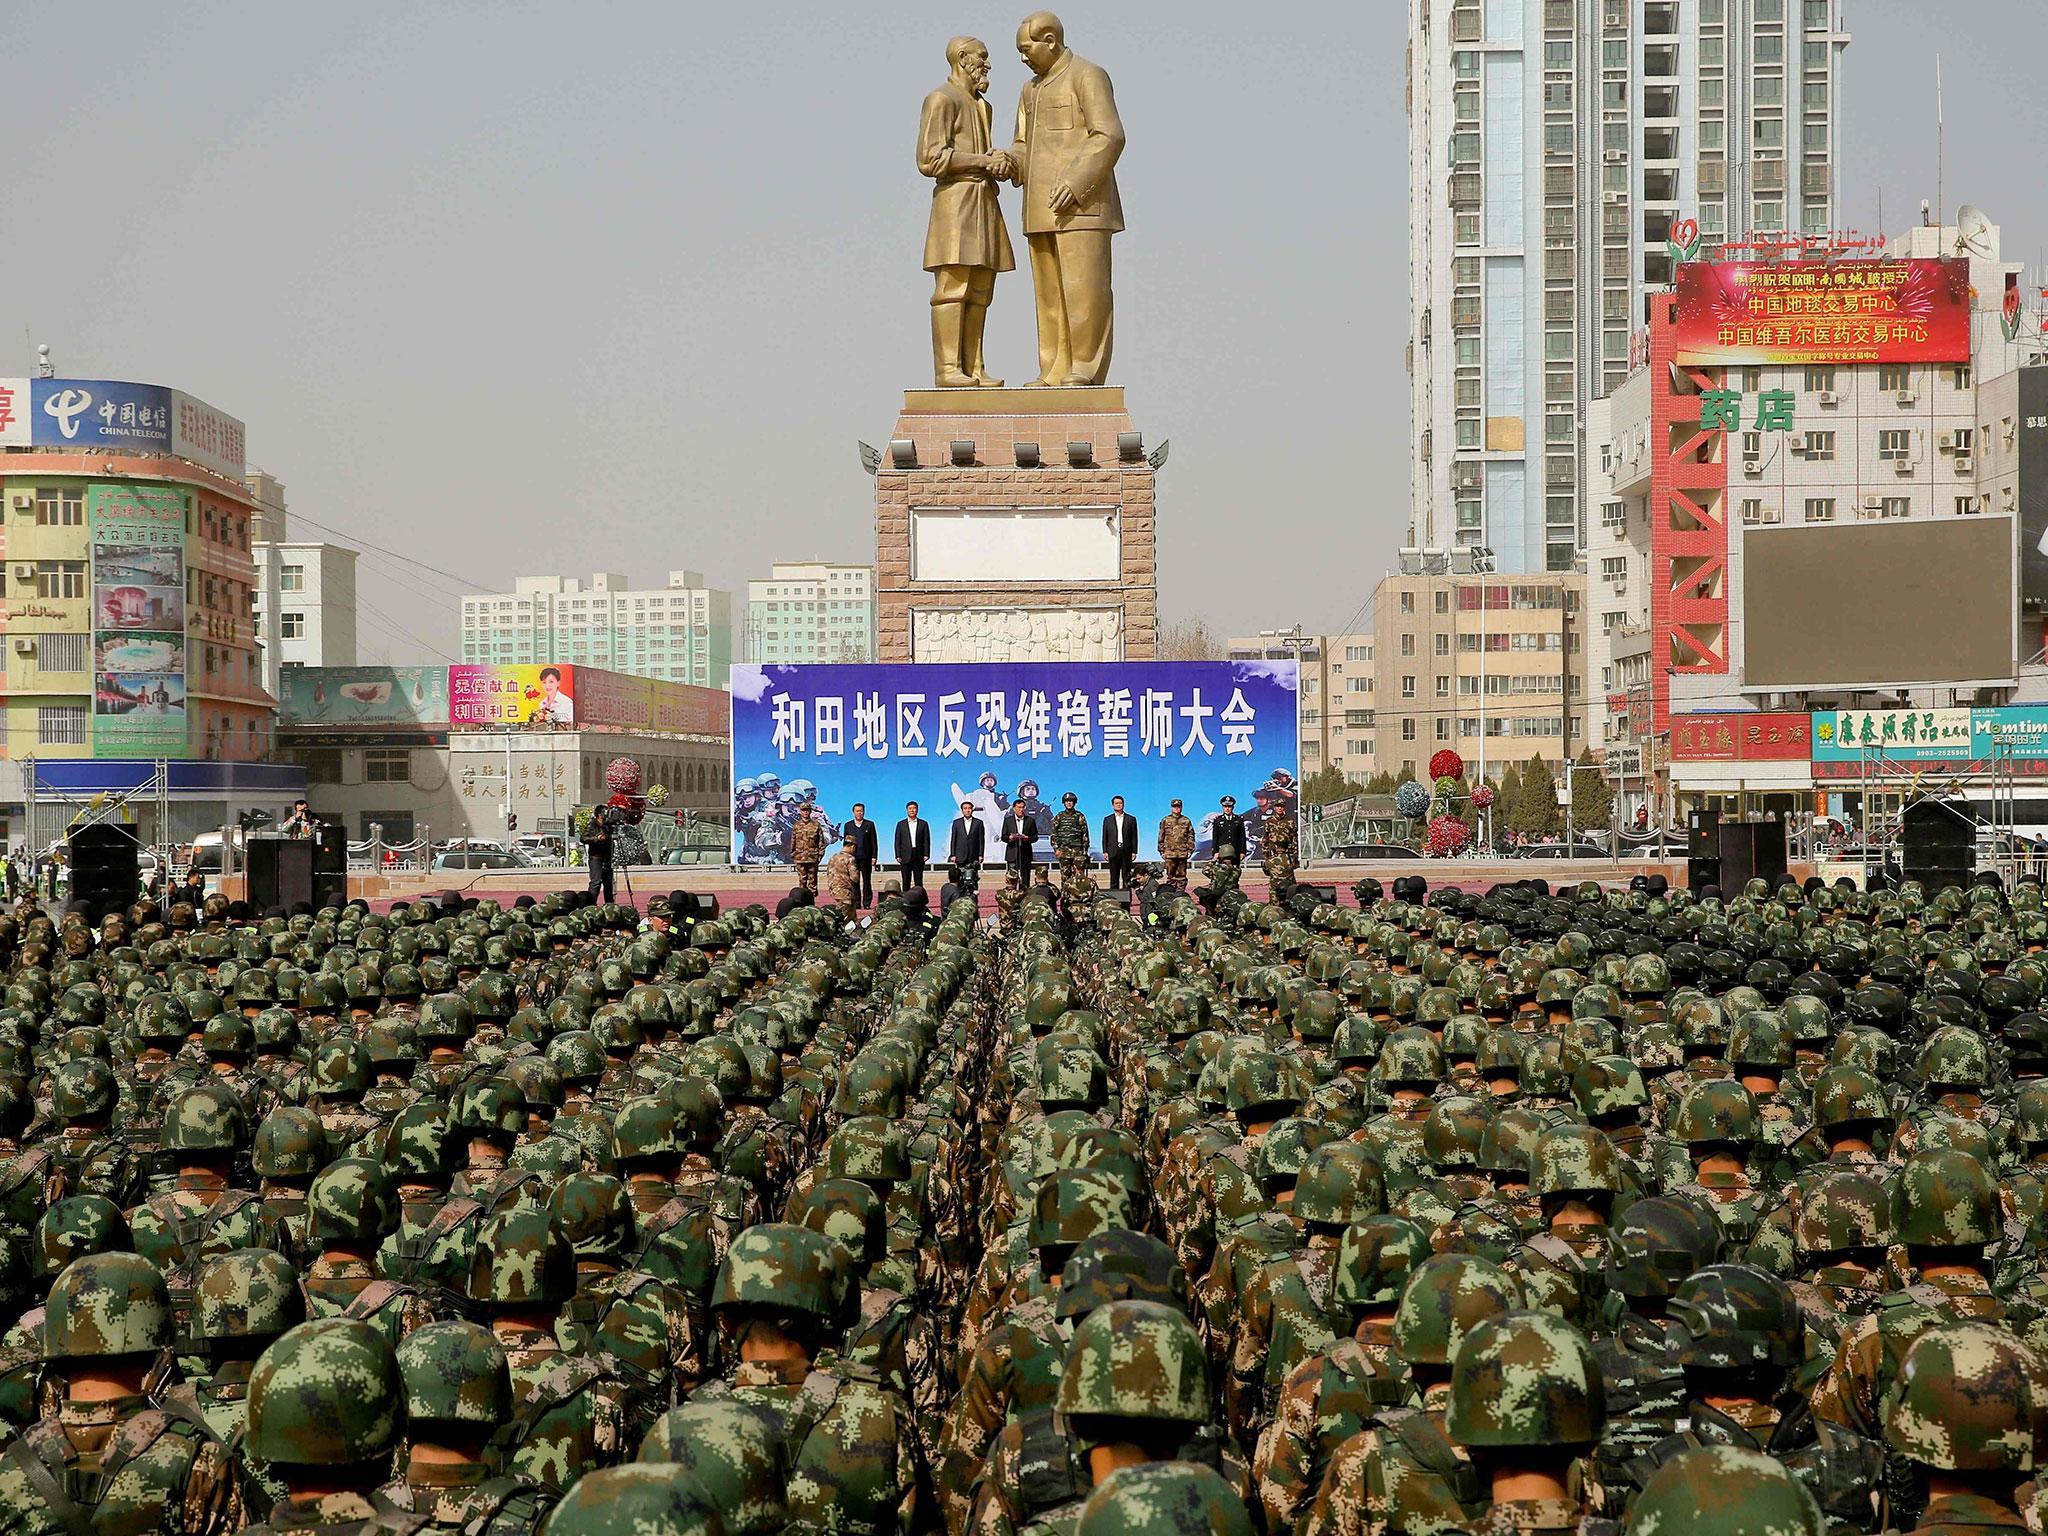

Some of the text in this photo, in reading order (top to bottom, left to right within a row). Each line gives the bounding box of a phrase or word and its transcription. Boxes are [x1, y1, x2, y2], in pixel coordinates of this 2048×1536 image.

[1747, 295, 1897, 315] 中国地毯交易中心
[1717, 325, 1929, 346] 中国维吾尔医药交易中心
[98, 400, 166, 428] 中国电信
[1700, 388, 1795, 433] 药店
[99, 426, 167, 440] CHINA TELECOM
[454, 678, 520, 695] 无偿献血
[454, 704, 520, 720] 利国利己
[771, 686, 1256, 760] 和田地区反恐维稳誓师大会
